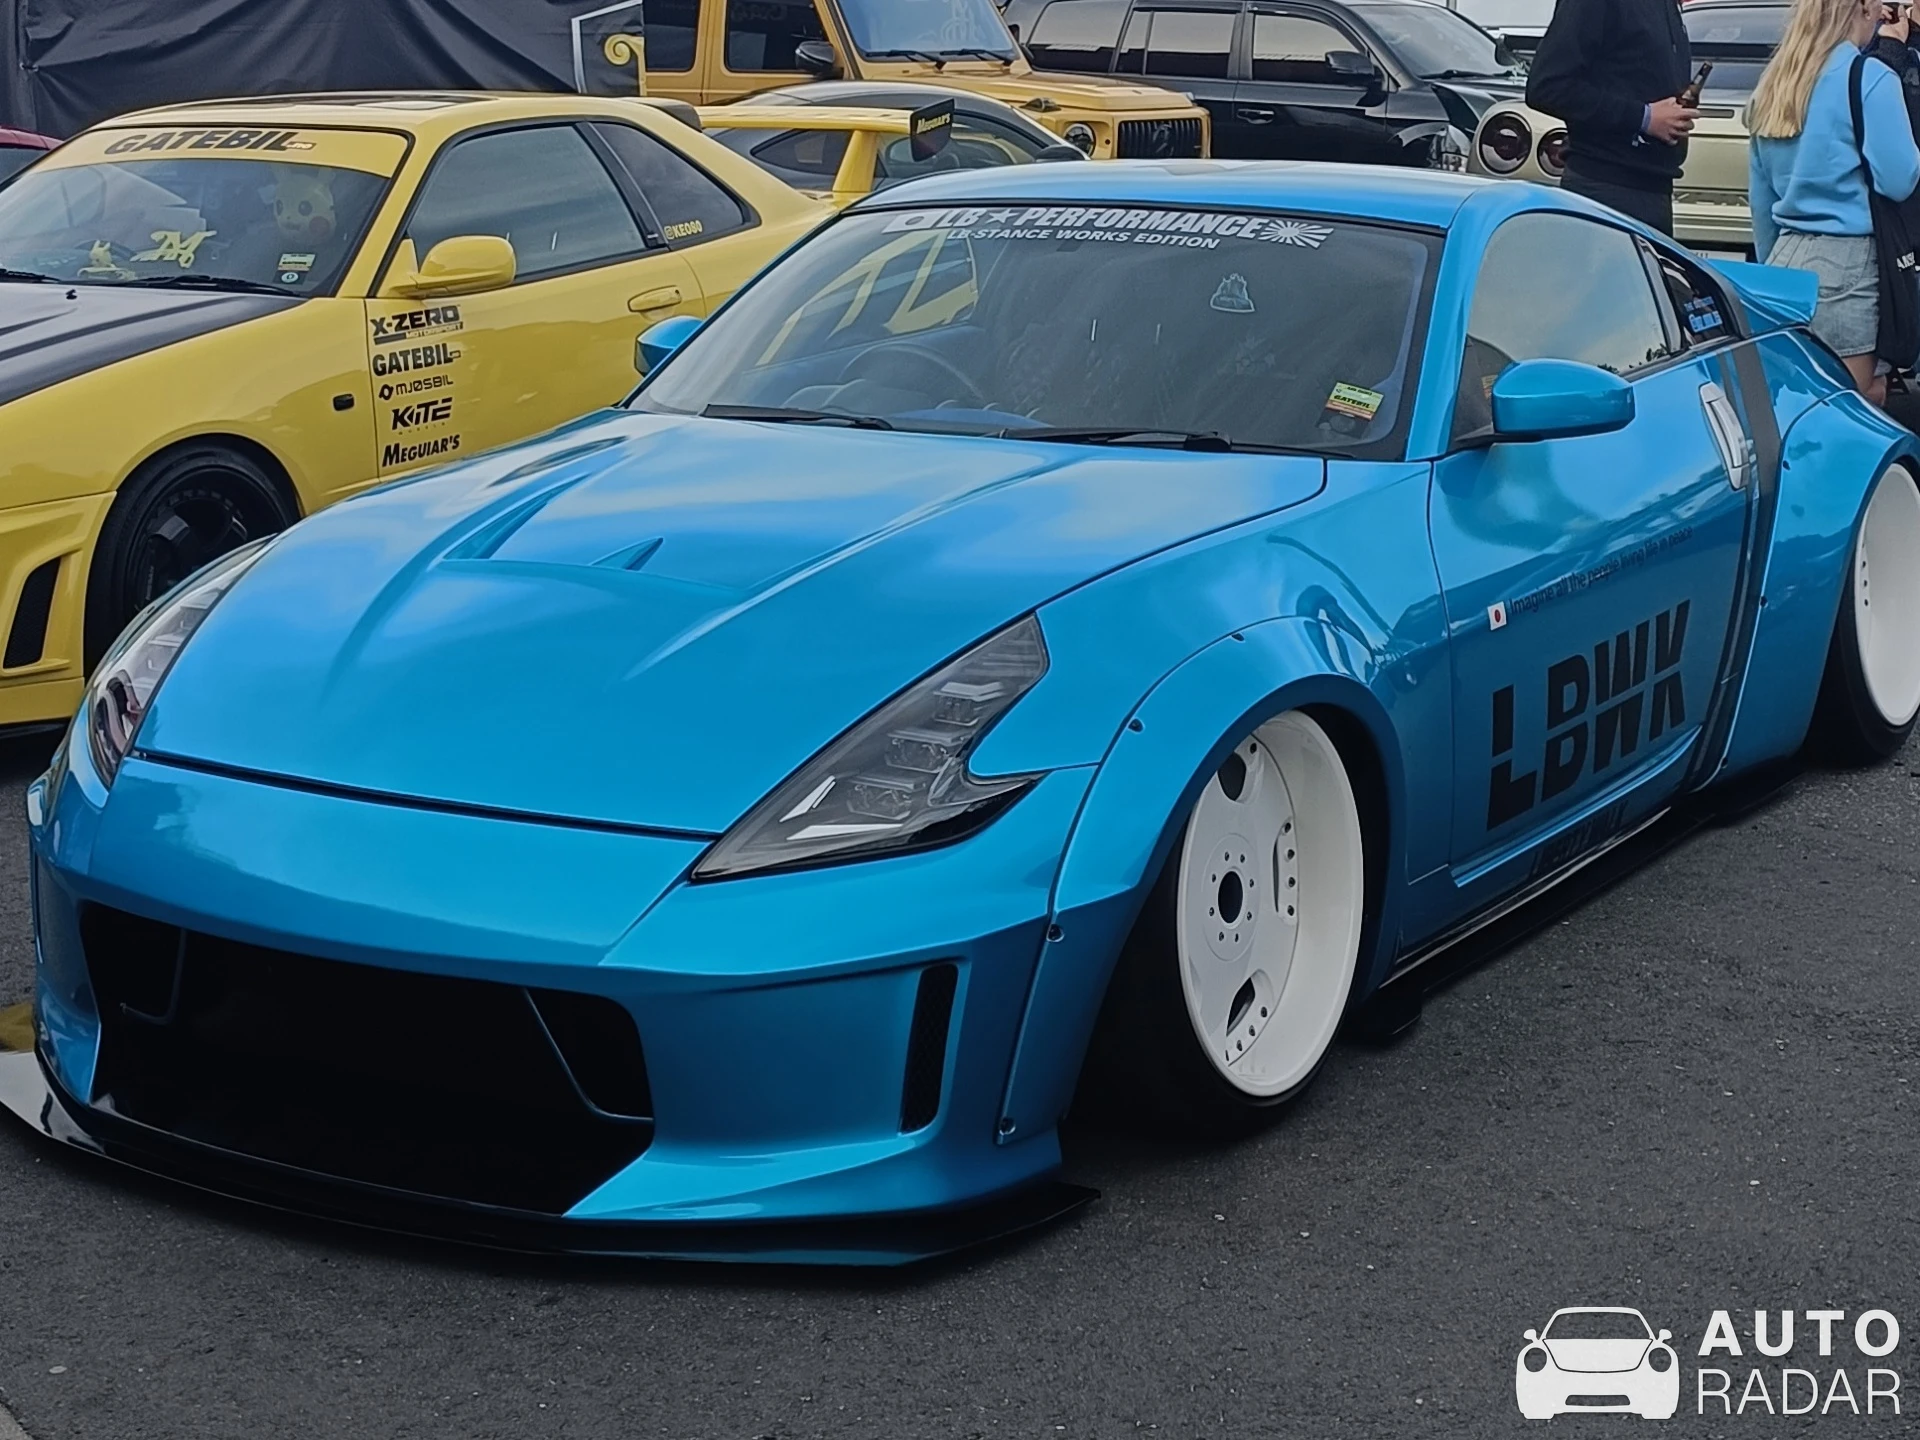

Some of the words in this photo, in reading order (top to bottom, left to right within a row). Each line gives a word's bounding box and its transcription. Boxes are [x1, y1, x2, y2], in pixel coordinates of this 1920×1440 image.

[936, 208, 988, 229] LB
[1013, 207, 1271, 239] PERFORMANCE
[947, 228, 1053, 240] LB-STANCE
[1056, 229, 1131, 242] WORKS
[1133, 232, 1221, 249] EDITION
[370, 305, 460, 337] X-ZERO
[372, 343, 454, 377] GATEBIL
[1509, 586, 1555, 614] Imagine
[1487, 599, 1691, 832] LBWK
